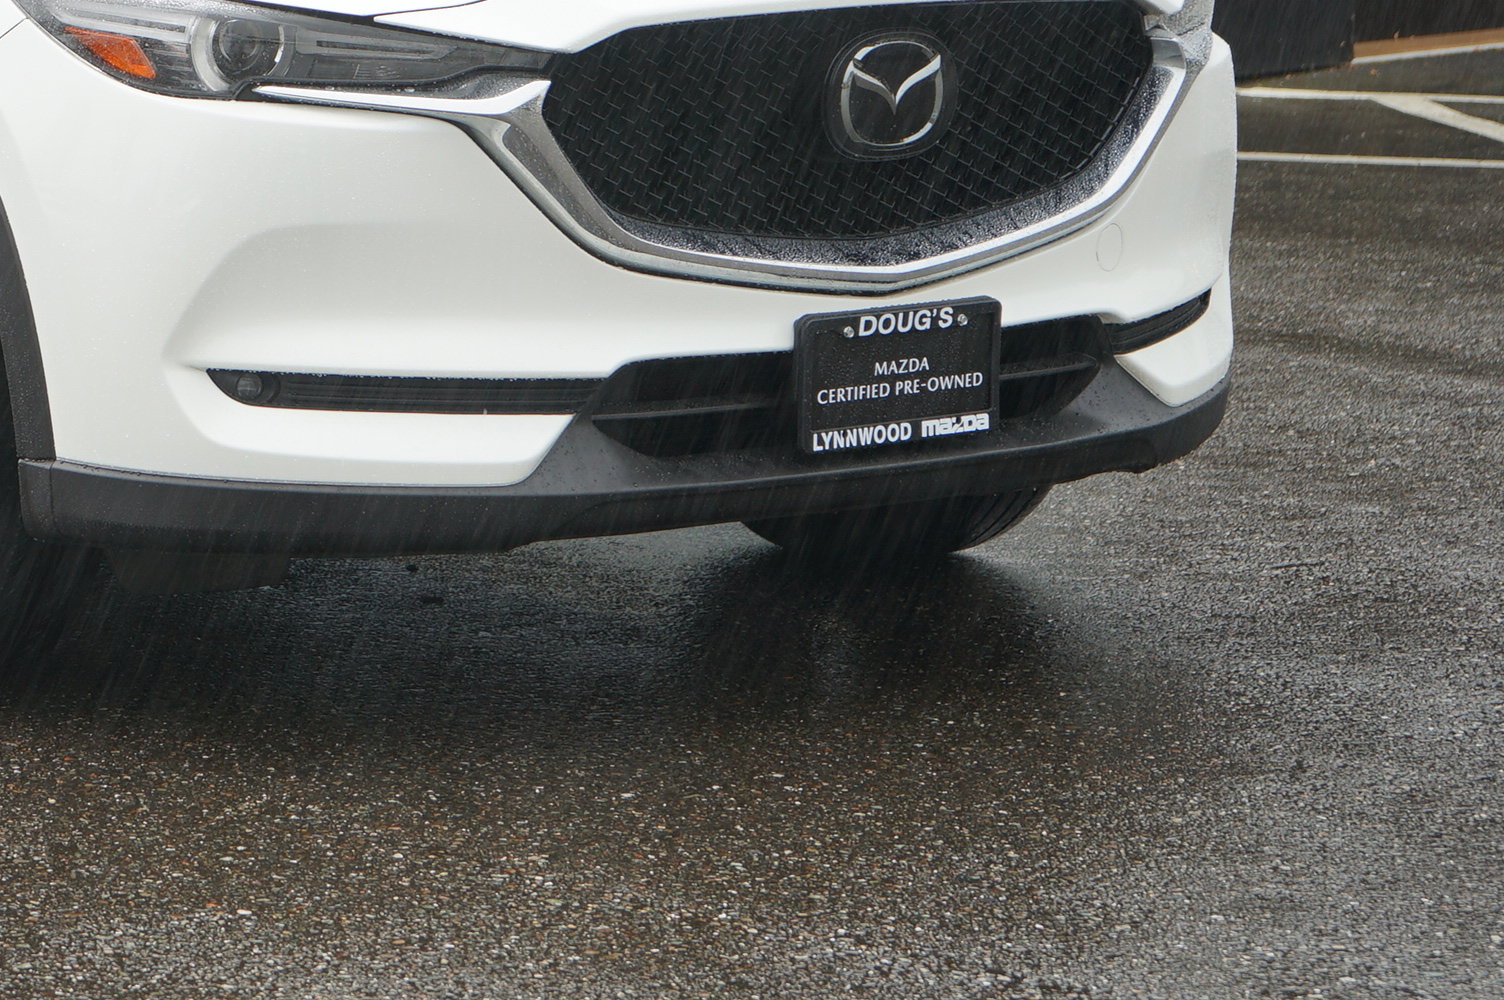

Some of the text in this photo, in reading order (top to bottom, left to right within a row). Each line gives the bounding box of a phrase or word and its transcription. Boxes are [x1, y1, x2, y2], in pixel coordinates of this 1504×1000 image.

[858, 307, 954, 337] DOUG'S
[874, 357, 930, 376] MAZDA
[817, 372, 983, 405] CERTIFIED PRE-OWNED
[812, 422, 913, 452] LYNNWOOD
